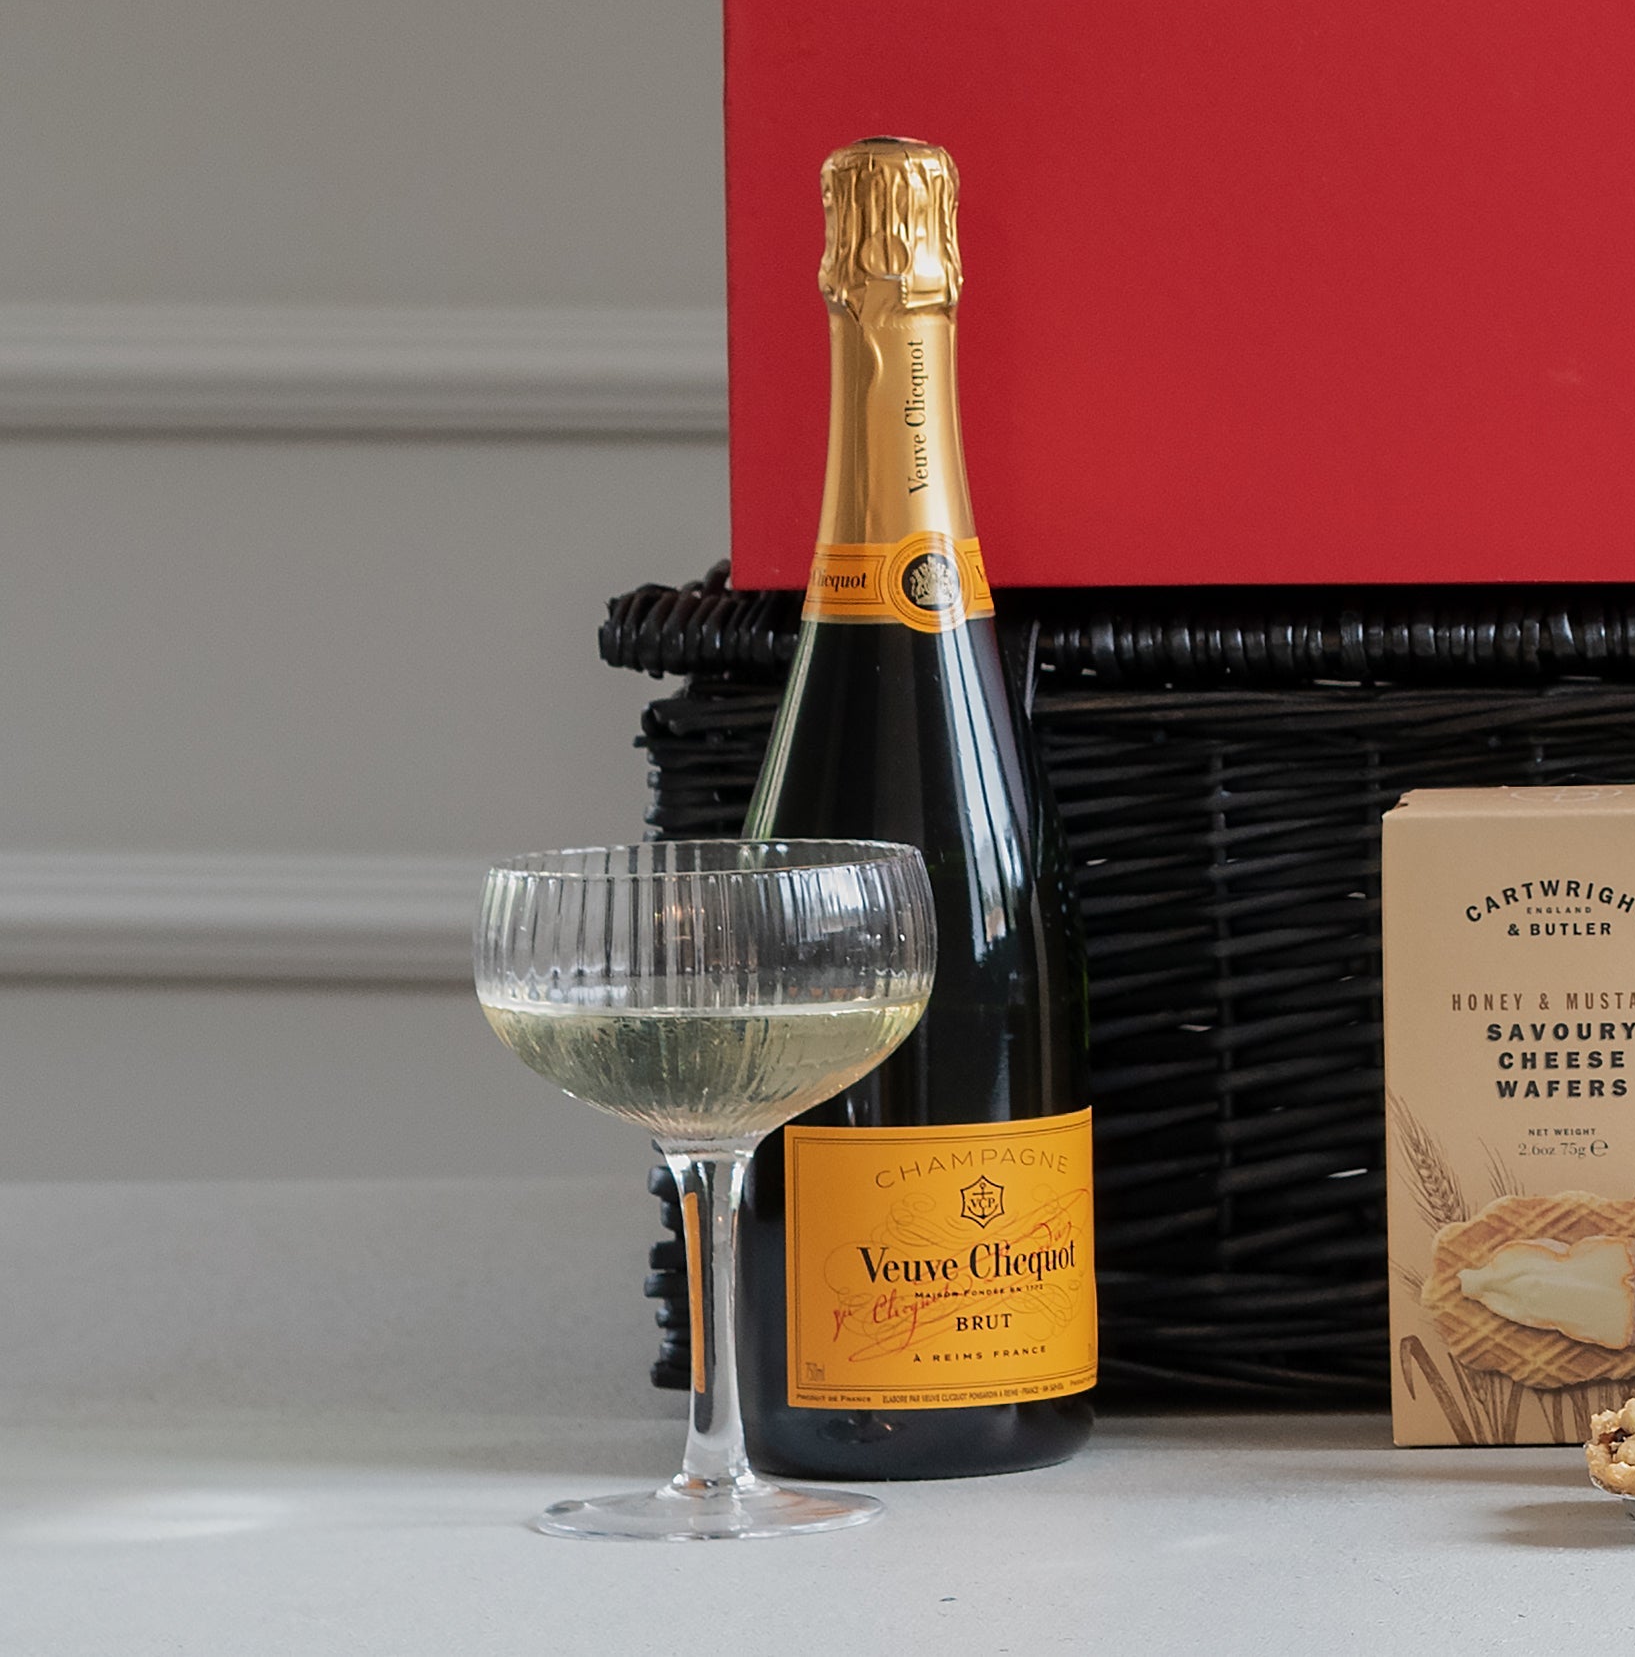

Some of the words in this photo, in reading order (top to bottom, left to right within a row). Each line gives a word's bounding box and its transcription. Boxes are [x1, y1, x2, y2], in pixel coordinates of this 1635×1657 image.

[904, 338, 930, 428] Clicquot
[908, 433, 931, 495] Veuve
[1527, 906, 1592, 914] ENGLAND
[1507, 923, 1520, 936] &
[1530, 922, 1612, 936] BUTLER
[1452, 993, 1523, 1011] HONEY
[1539, 992, 1550, 1010] &
[1498, 1051, 1625, 1070] CHEESE
[1496, 1079, 1628, 1098] WAFERS
[1554, 1128, 1596, 1136] WEIGHT
[1560, 1142, 1586, 1159] 75g
[874, 1147, 1069, 1190] CHAMPAGNE
[970, 1197, 995, 1208] VCP
[857, 1246, 958, 1283] Veuve
[969, 1240, 1075, 1281] Clicquot
[956, 1313, 1013, 1332] BRUT
[932, 1352, 983, 1362] REIMS
[993, 1345, 1047, 1358] FRANCE
